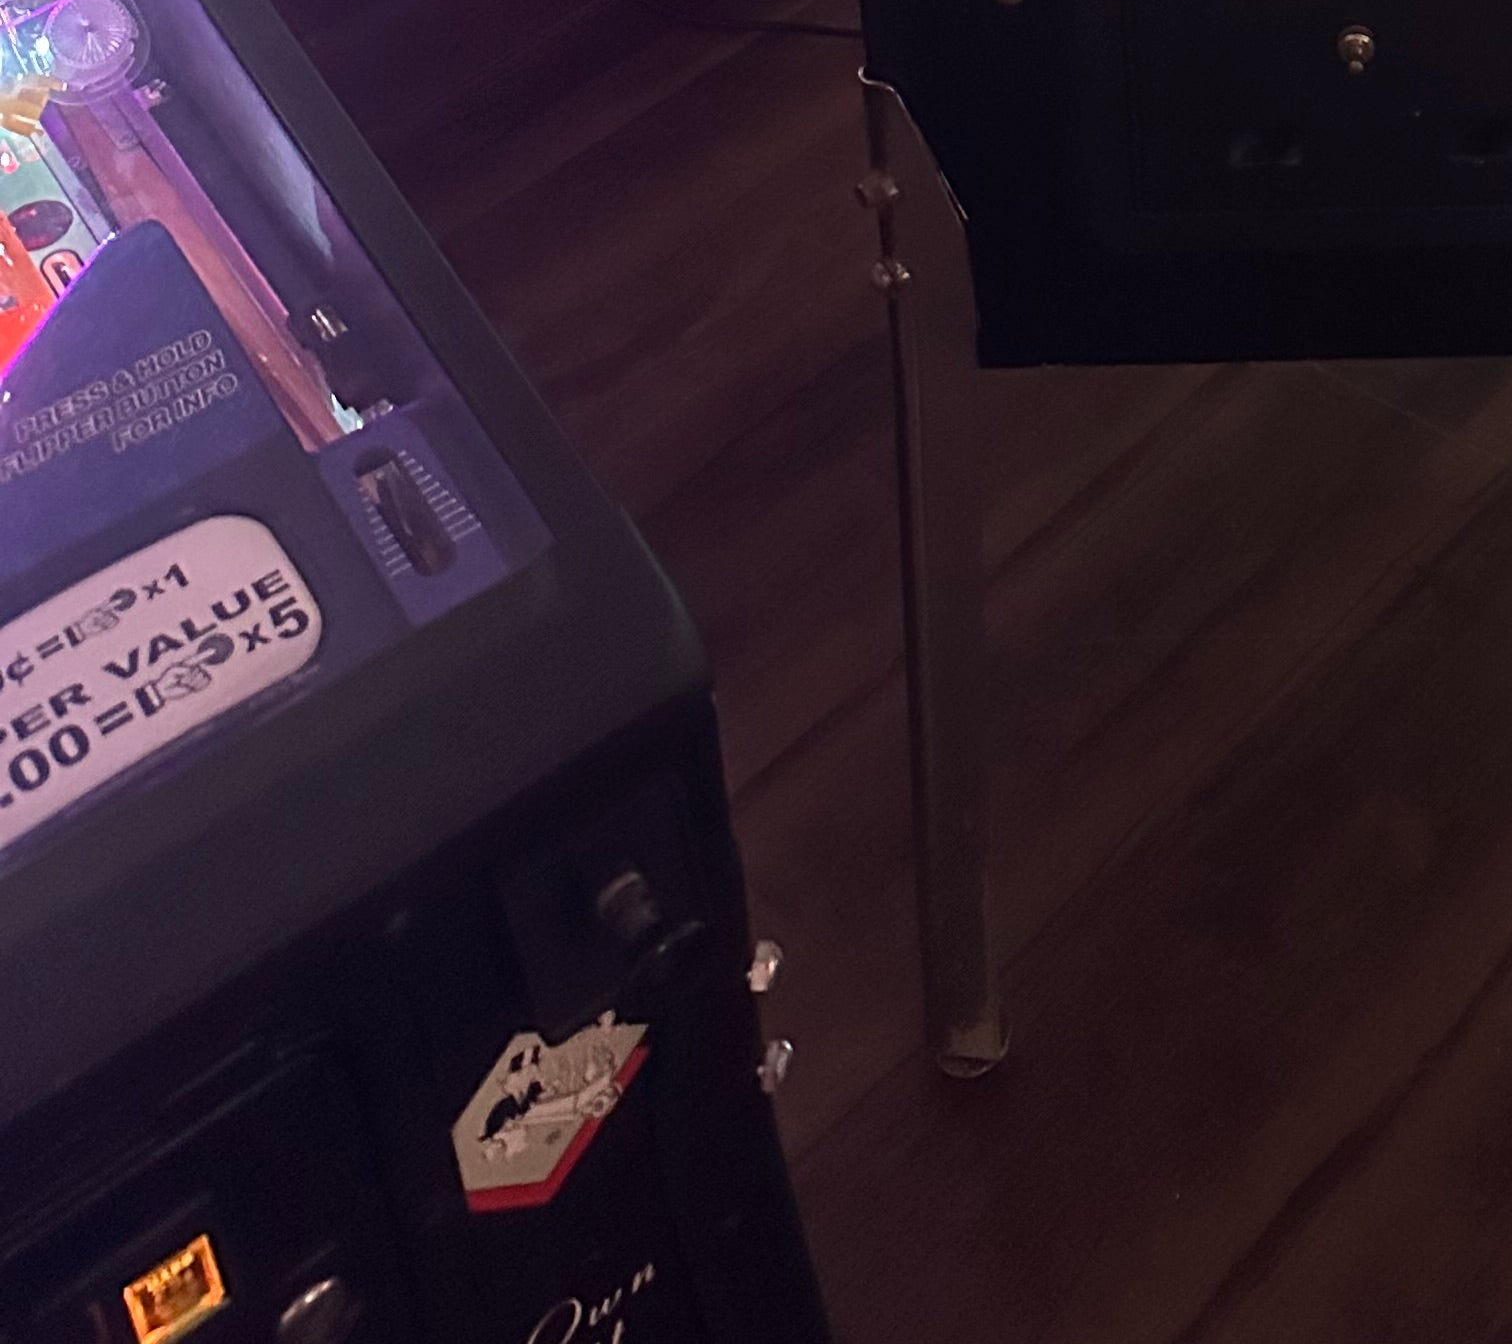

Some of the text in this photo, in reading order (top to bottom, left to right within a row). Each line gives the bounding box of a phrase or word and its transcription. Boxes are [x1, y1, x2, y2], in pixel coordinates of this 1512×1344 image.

[0, 348, 227, 483] FLIPPER BUTTON
[14, 376, 111, 440] PRESS
[135, 328, 214, 382] HOLD
[111, 372, 239, 455] FOR INFO
[103, 567, 292, 679] VALUE
